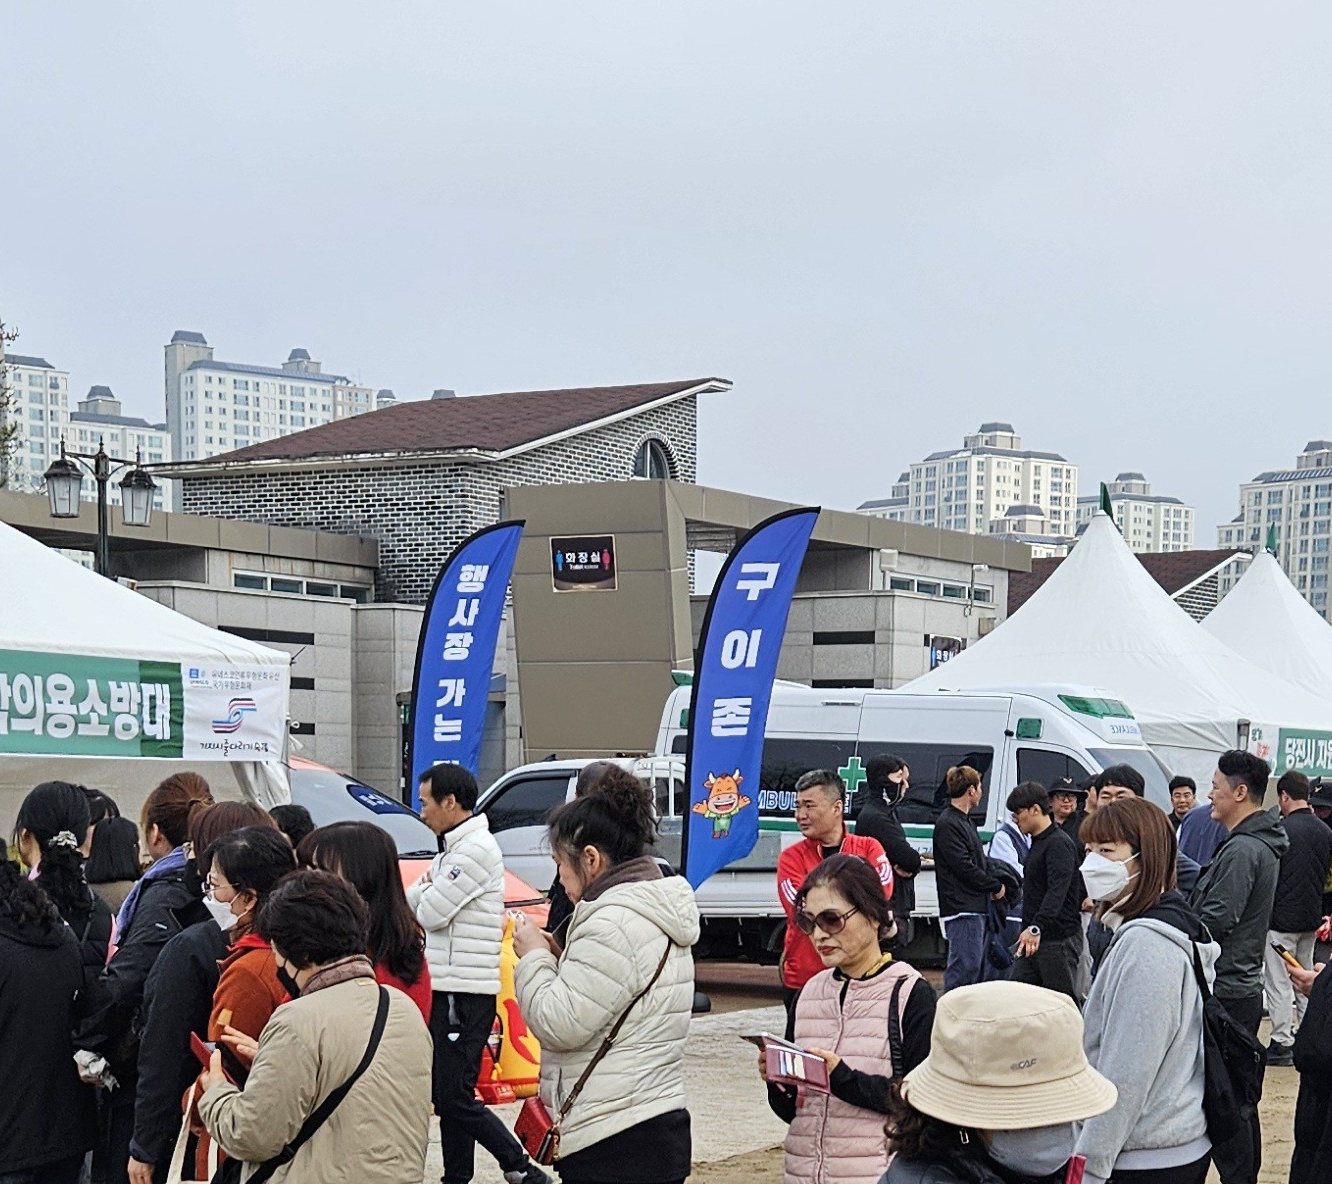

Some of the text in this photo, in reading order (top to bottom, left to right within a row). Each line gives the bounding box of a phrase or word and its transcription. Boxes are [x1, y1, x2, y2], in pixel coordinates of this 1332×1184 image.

[565, 551, 601, 563] 화장실
[443, 565, 489, 661] 행사장
[711, 563, 781, 737] 구이존
[433, 678, 466, 742] 가는
[1285, 737, 1315, 769] 당진시
